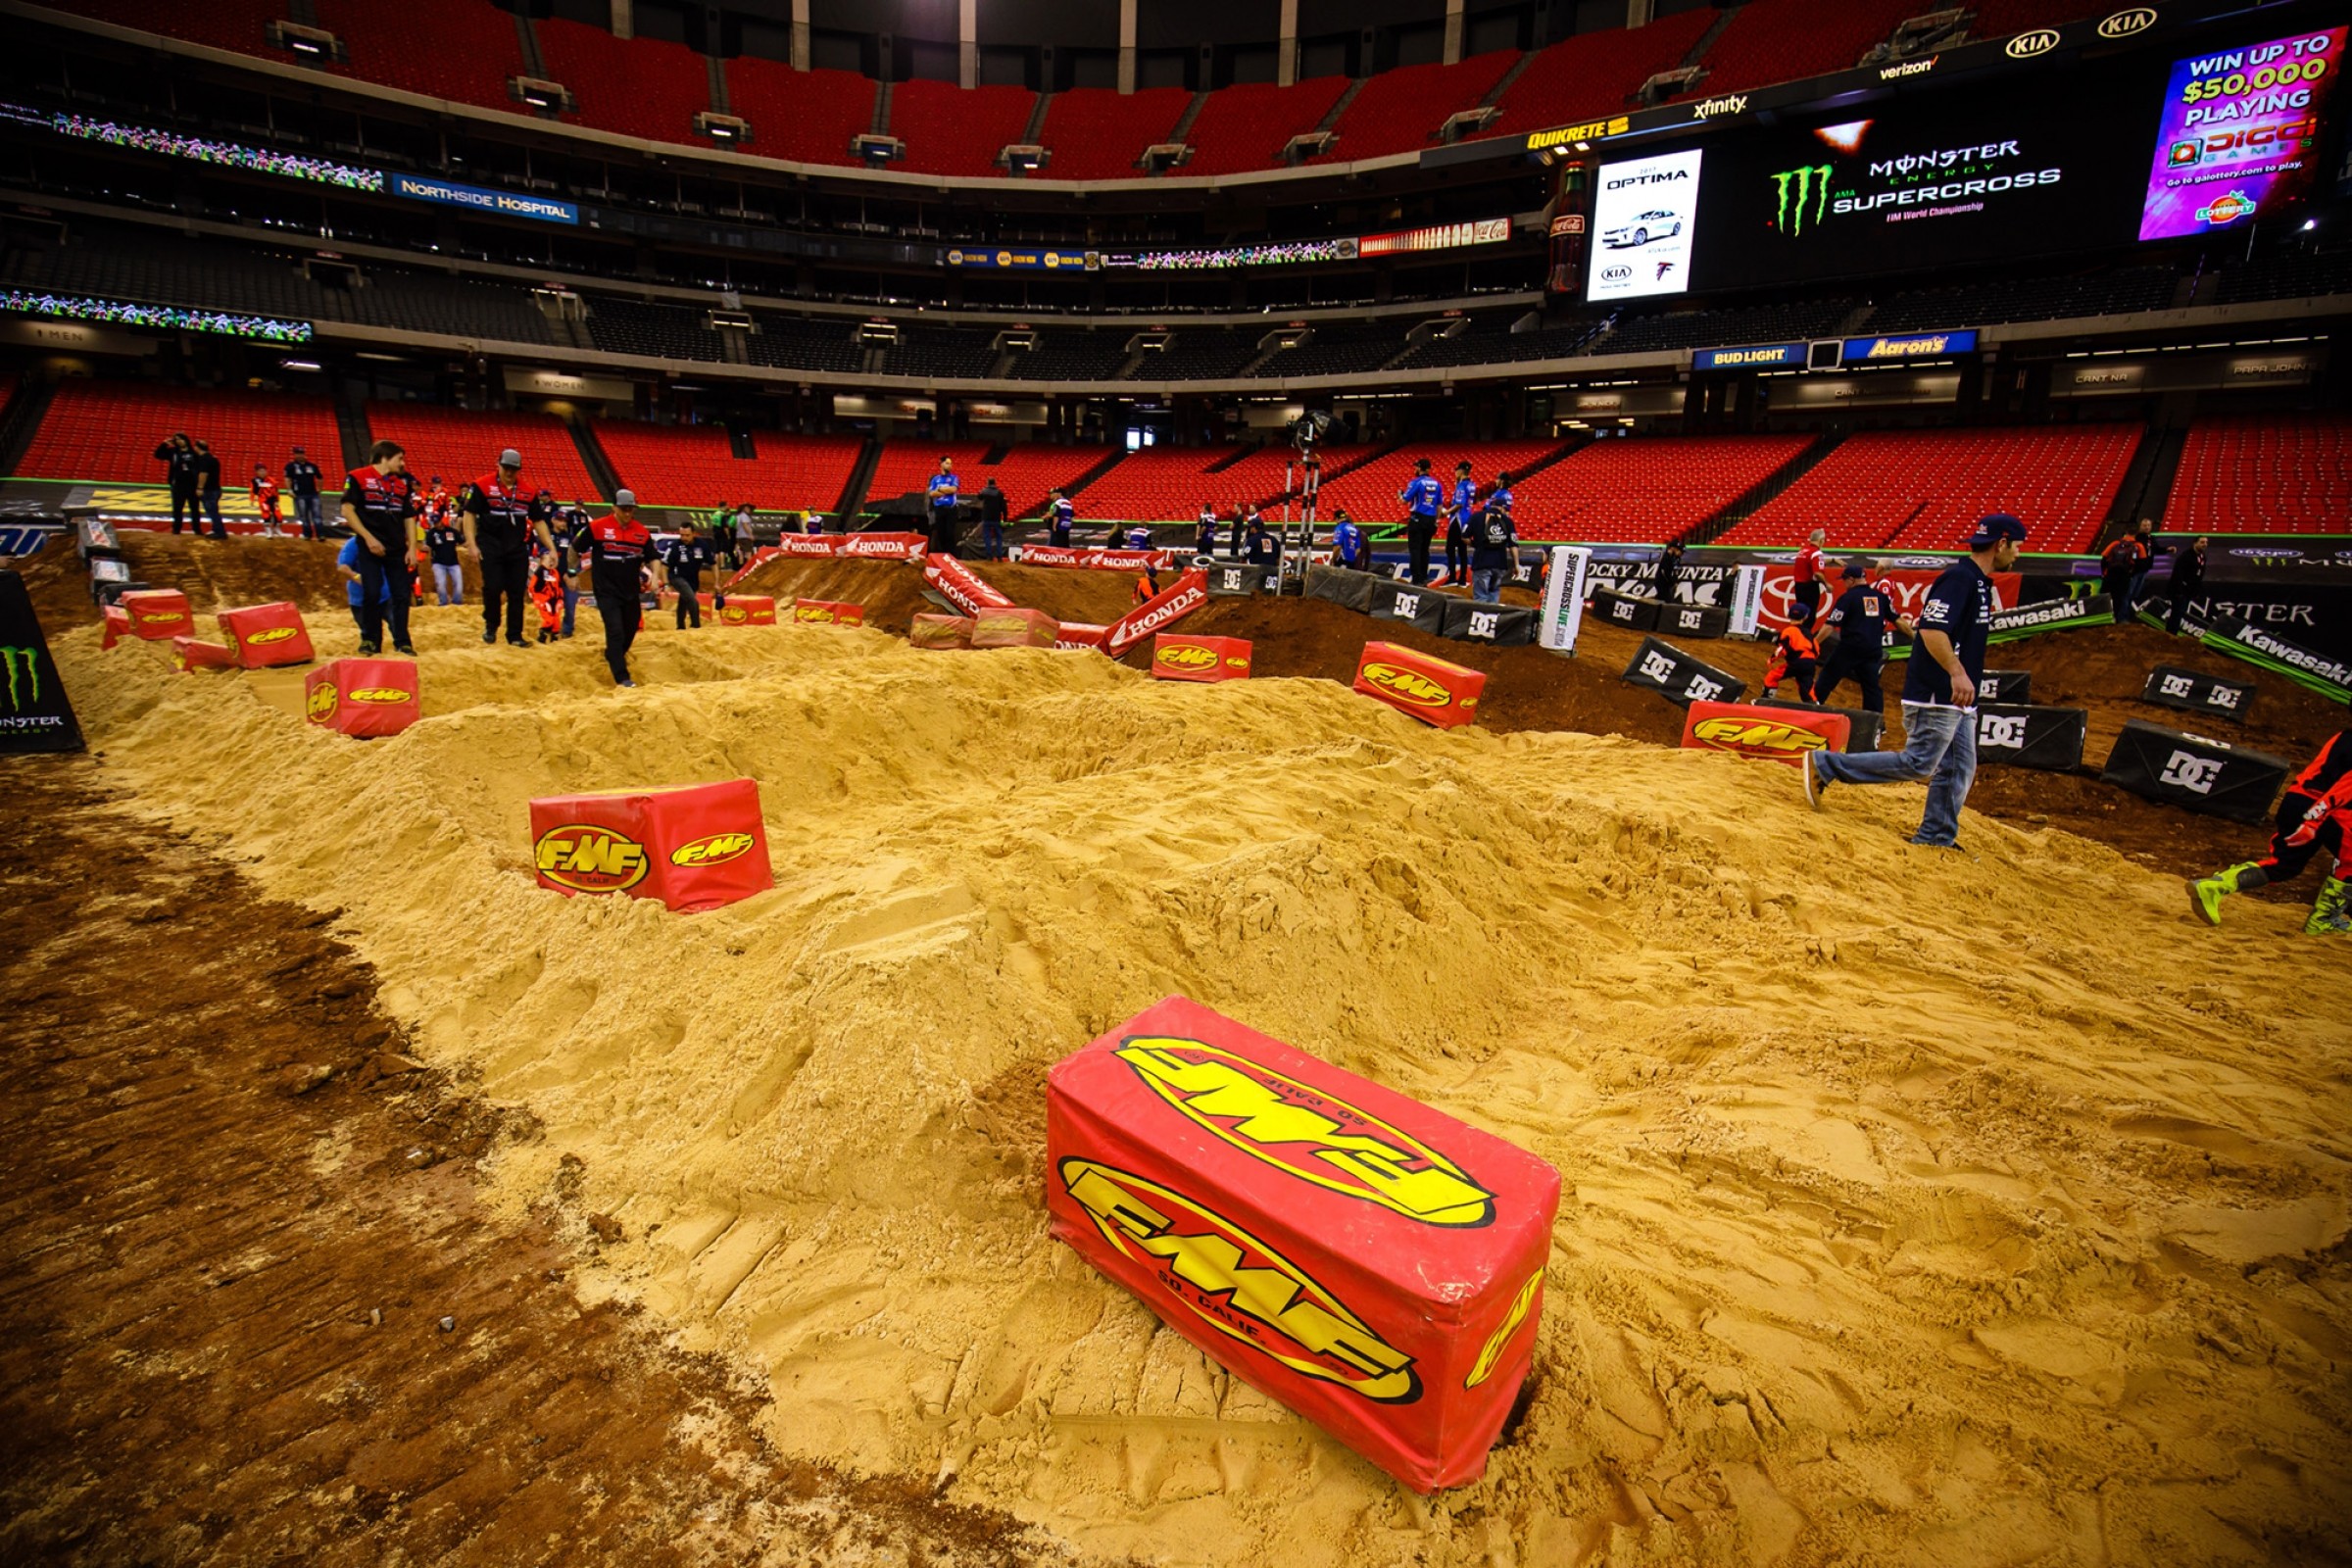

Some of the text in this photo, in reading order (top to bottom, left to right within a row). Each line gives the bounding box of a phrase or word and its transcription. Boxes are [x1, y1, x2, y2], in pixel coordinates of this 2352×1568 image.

[2107, 12, 2147, 34] KIA
[2014, 33, 2052, 54] KIA
[2189, 35, 2329, 76] WIN UP TO
[1880, 59, 1932, 79] verizon
[2182, 58, 2327, 104] $50,000
[1693, 95, 1747, 119] xfinity
[2184, 89, 2311, 126] PLAYING
[1528, 122, 1606, 149] QUIKRETE
[1869, 140, 2021, 177] MONSTER
[1607, 170, 1689, 190] OPTIMA
[1889, 164, 1994, 185] ENERGY
[2194, 167, 2263, 183] galottery.com
[2265, 164, 2276, 172] to
[2278, 160, 2303, 172] play.
[401, 178, 570, 220] NORTHSIDE HOSPITAL
[1833, 168, 2061, 214] SUPERCROSS
[1835, 189, 1855, 198] AMA
[1903, 209, 1928, 220] World
[1929, 201, 1984, 217] Championship
[2199, 203, 2254, 218] LOTTERY
[1606, 268, 1628, 279] KIA
[49, 330, 82, 341] MEN
[1869, 335, 1948, 358] Aaron's
[1714, 349, 1786, 366] BUD LIGHT
[2234, 364, 2268, 375] PAPA
[543, 380, 585, 390] WOMEN
[792, 542, 831, 554] HONDA
[858, 541, 906, 553] HONDA
[1034, 553, 1076, 564] HONDA
[1588, 563, 1635, 577] OCKY
[939, 575, 980, 614] HOND
[1129, 586, 1204, 638] HONDA
[1157, 649, 1218, 664] FMF
[1363, 663, 1451, 702] FMF
[0, 715, 64, 728] NSTER
[1694, 720, 1828, 752] FMF
[536, 833, 643, 876] FMF
[673, 833, 753, 865] FMF
[1110, 1045, 1497, 1215] FMF
[1067, 1167, 1418, 1382] FMF
[1157, 1269, 1266, 1347] SO. CALIF.
